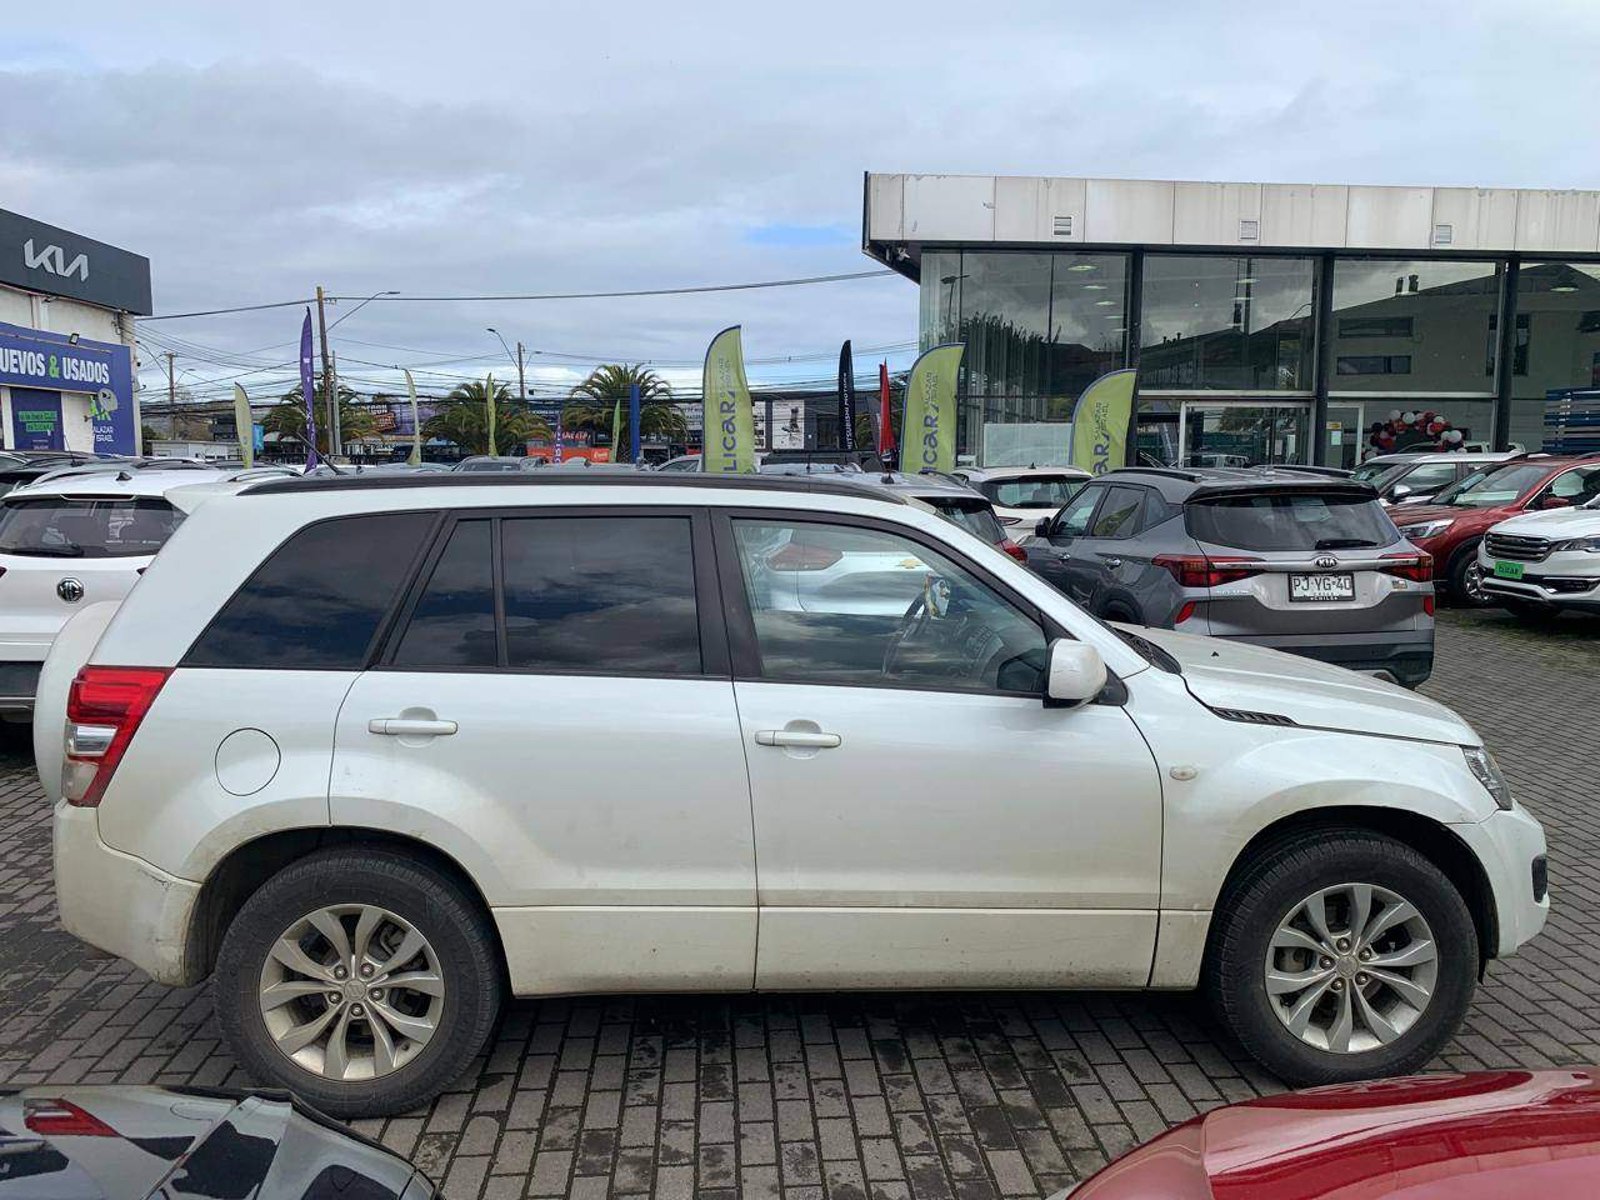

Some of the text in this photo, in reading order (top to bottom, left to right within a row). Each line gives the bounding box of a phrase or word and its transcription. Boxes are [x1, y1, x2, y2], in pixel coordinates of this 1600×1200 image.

[0, 347, 110, 385] UEVOS & USADOS
